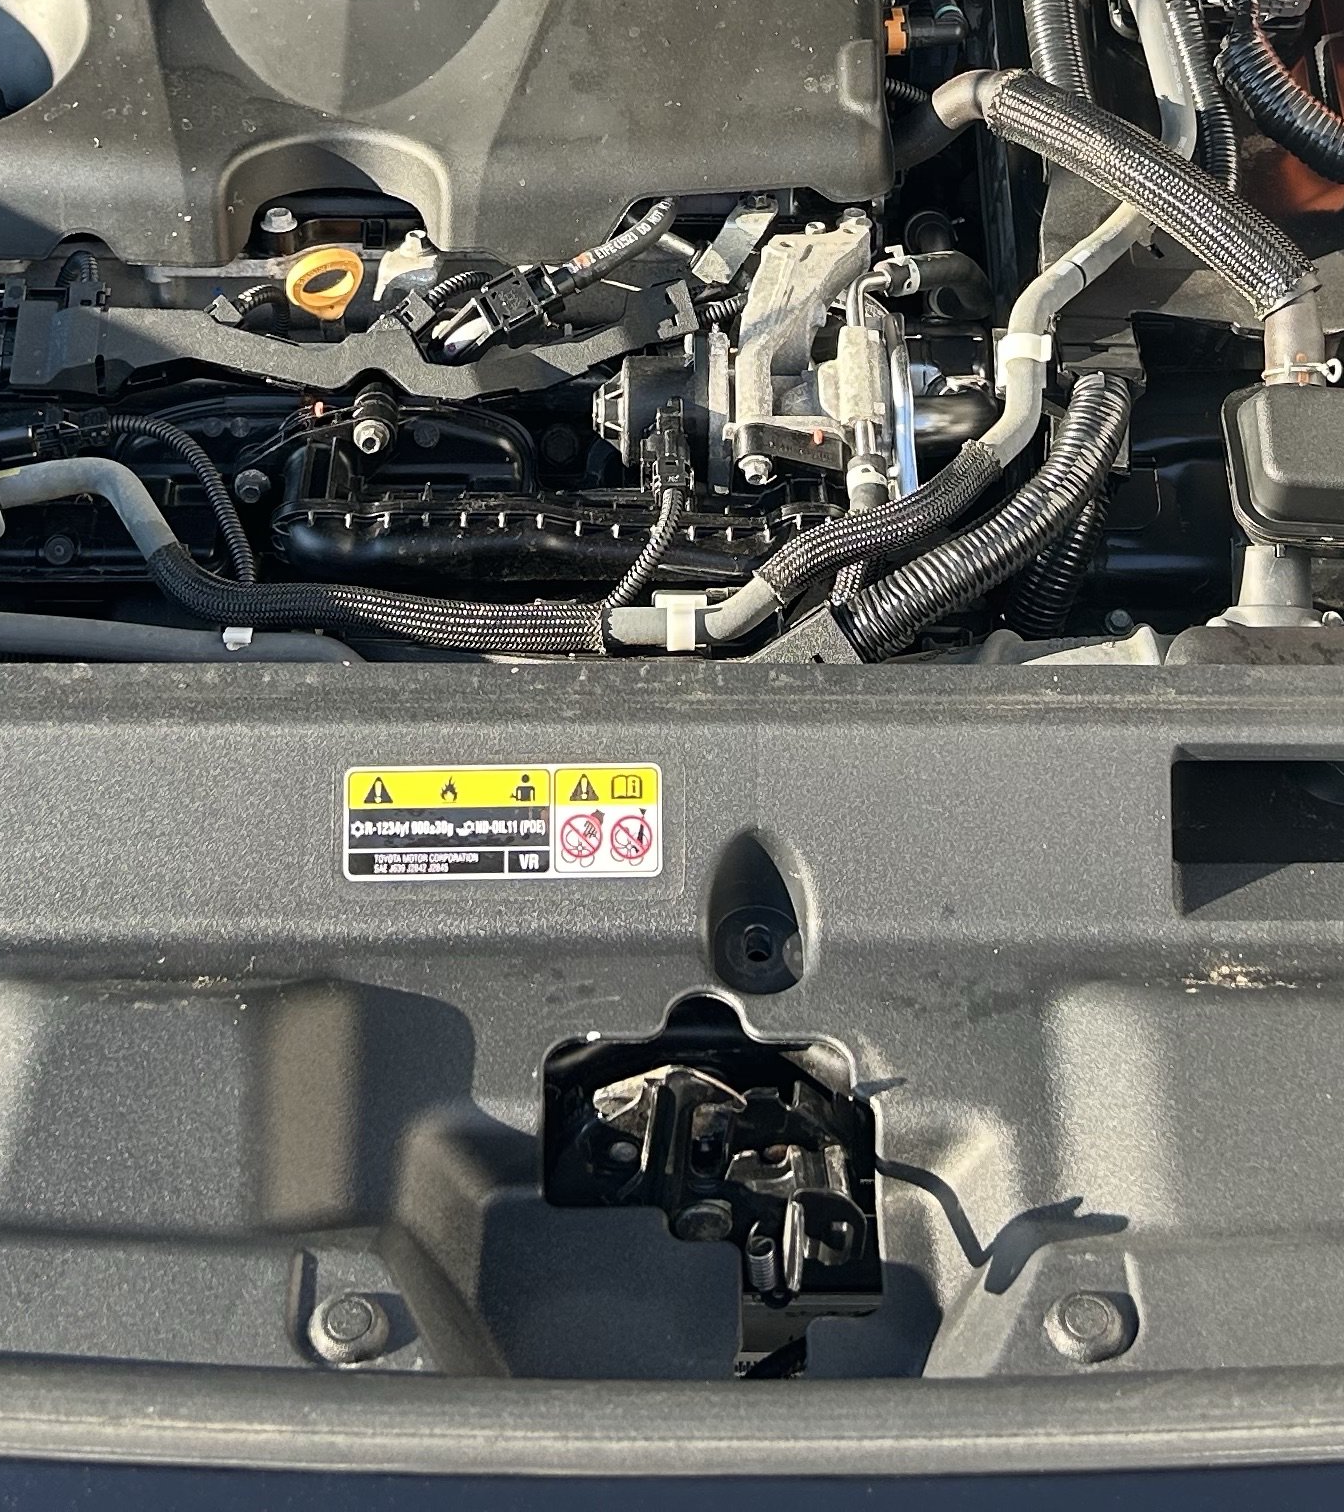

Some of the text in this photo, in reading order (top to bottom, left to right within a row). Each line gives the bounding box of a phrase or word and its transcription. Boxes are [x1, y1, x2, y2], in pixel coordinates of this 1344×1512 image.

[635, 222, 652, 236] DO
[646, 209, 665, 226] NOT
[374, 853, 480, 864] TOYOTA MOTOR CORPORATION
[519, 853, 540, 871] VR
